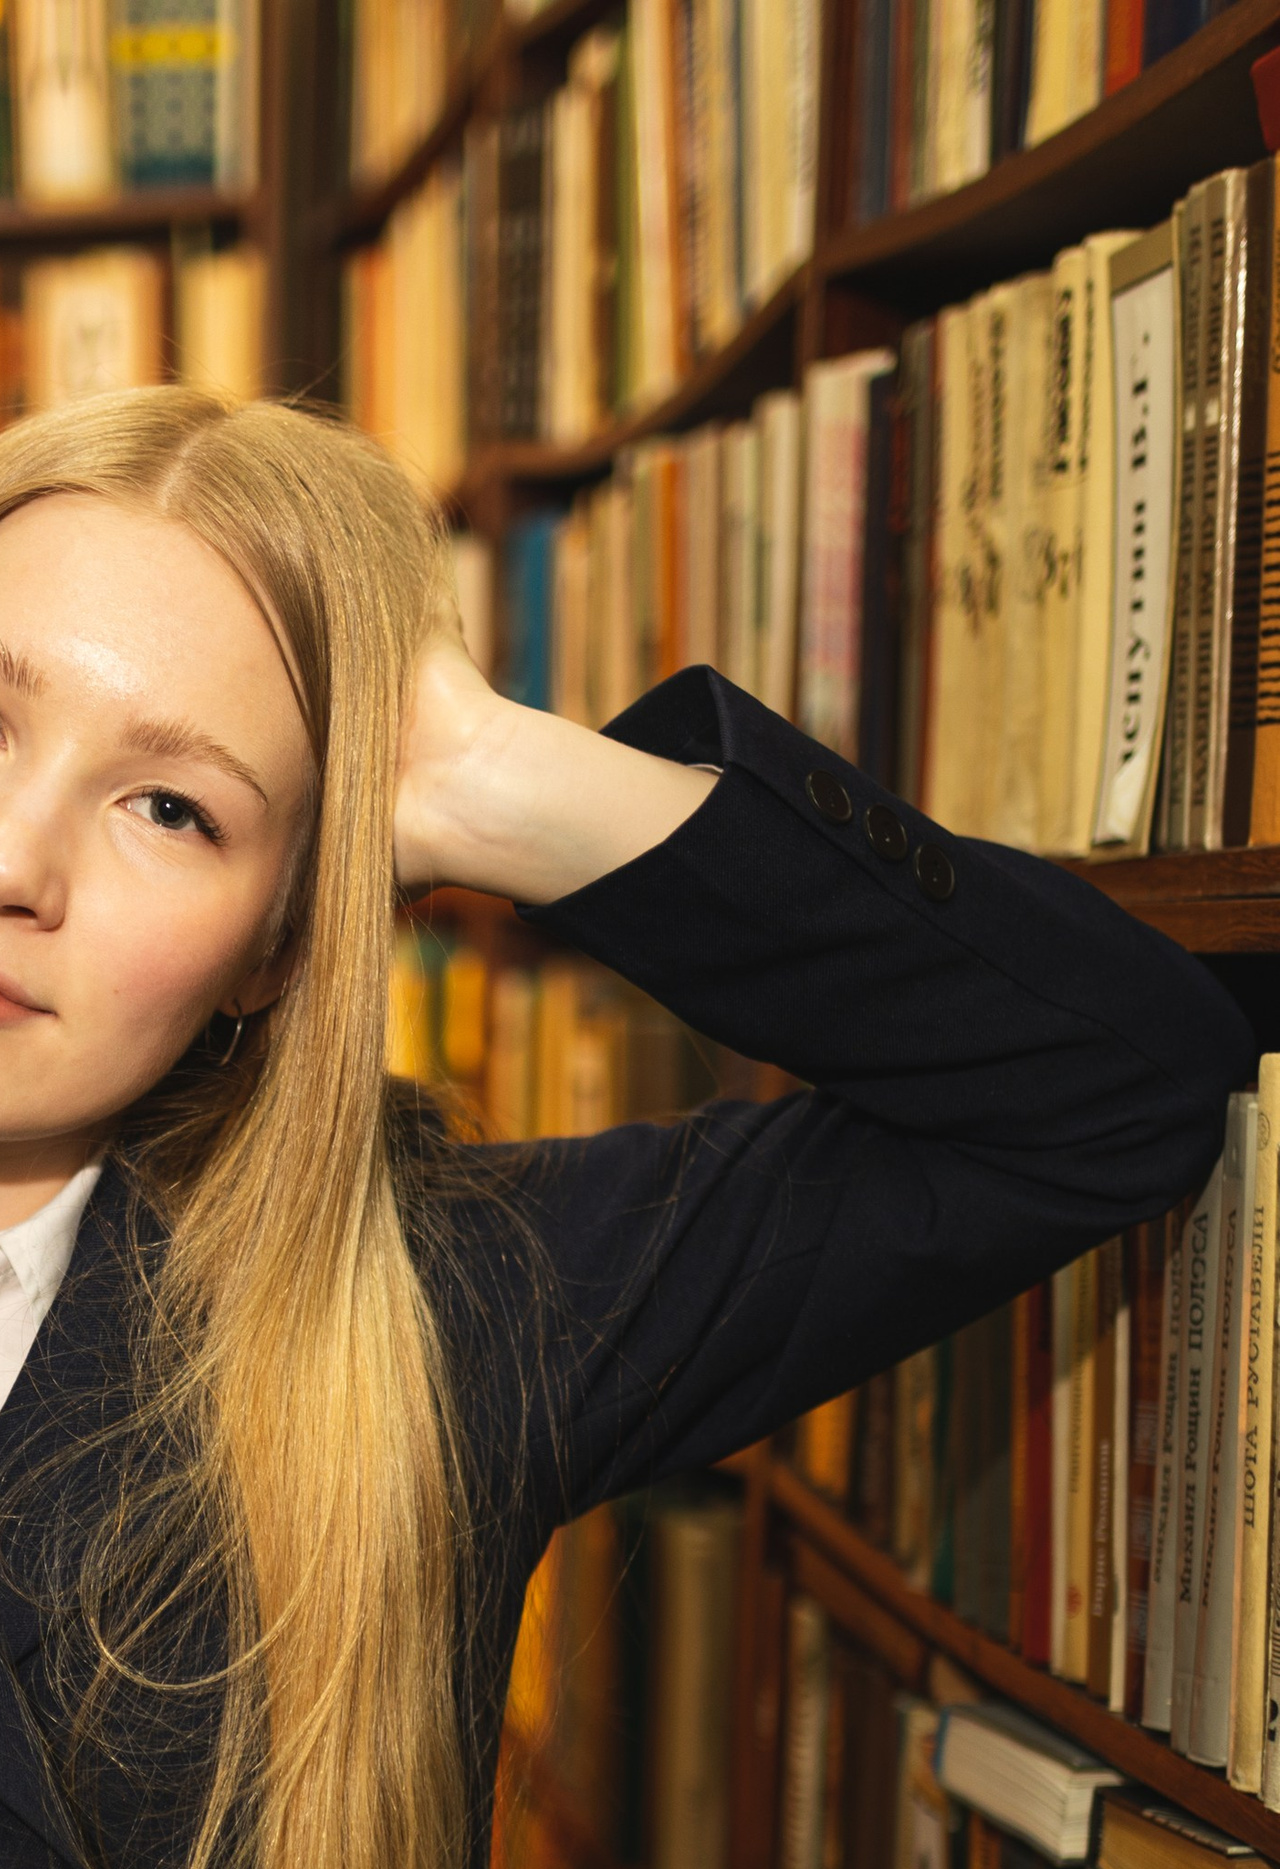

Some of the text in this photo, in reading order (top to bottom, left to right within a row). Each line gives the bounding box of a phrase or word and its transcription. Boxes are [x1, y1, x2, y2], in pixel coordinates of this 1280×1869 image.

[1179, 1211, 1208, 1604] Михаил Рощин ПОЛОСА
[1202, 1208, 1237, 1609] Михаил Рощин ПОЛОСА
[1243, 1205, 1264, 1530] ШОТА РУСТАВЕЛИ
